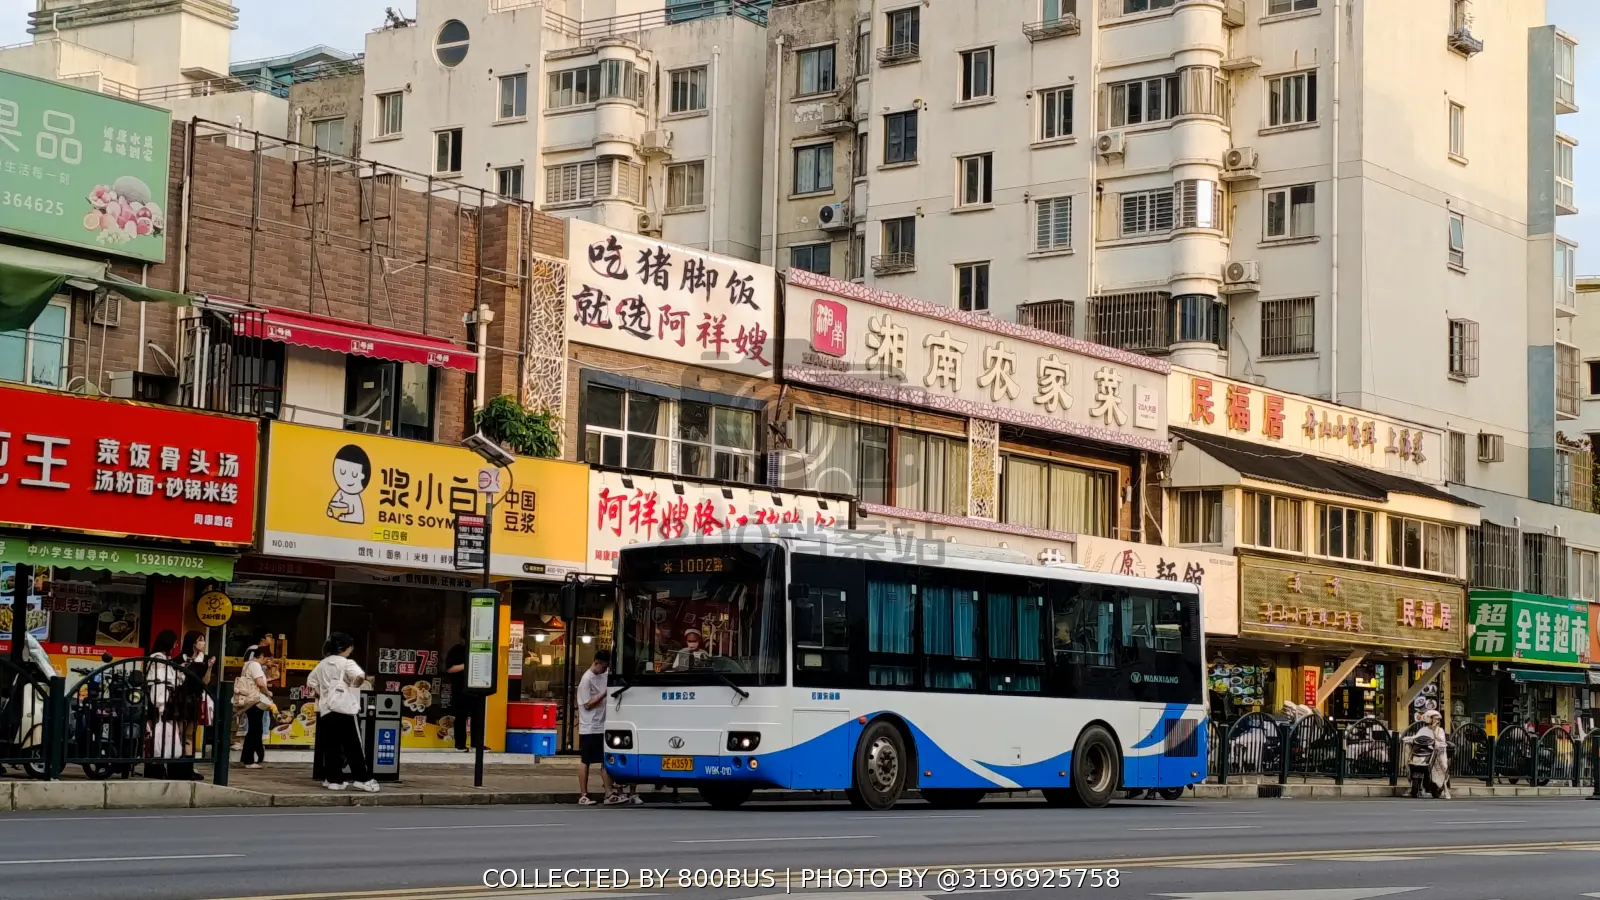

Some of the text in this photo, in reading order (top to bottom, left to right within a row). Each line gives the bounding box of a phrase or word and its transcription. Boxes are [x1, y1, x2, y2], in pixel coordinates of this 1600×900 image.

[0, 160, 70, 185] 生活每一刻
[3, 190, 64, 216] 364625
[588, 235, 760, 311] 吃猪脚饭
[572, 284, 772, 367] 就选阿祥嫂
[865, 313, 1129, 427] 湘南农家菜
[1191, 378, 1286, 441] 民福居
[96, 437, 239, 481] 菜饭骨头汤
[95, 470, 238, 505] 汤粉面·砂锅米线
[379, 467, 478, 514] 浆小白
[504, 488, 536, 513] 中国
[378, 511, 414, 527] BAI'S
[417, 515, 457, 532] SOYM
[504, 511, 537, 535] 豆浆
[272, 539, 297, 548] NO.001
[372, 531, 408, 543] 一日四餐
[28, 544, 120, 563] 中小学生辅导中心
[135, 553, 204, 568] 15921677052
[1475, 603, 1508, 653] 超市
[1515, 608, 1588, 659] 全佳超市
[1143, 676, 1180, 686] WANXIANG
